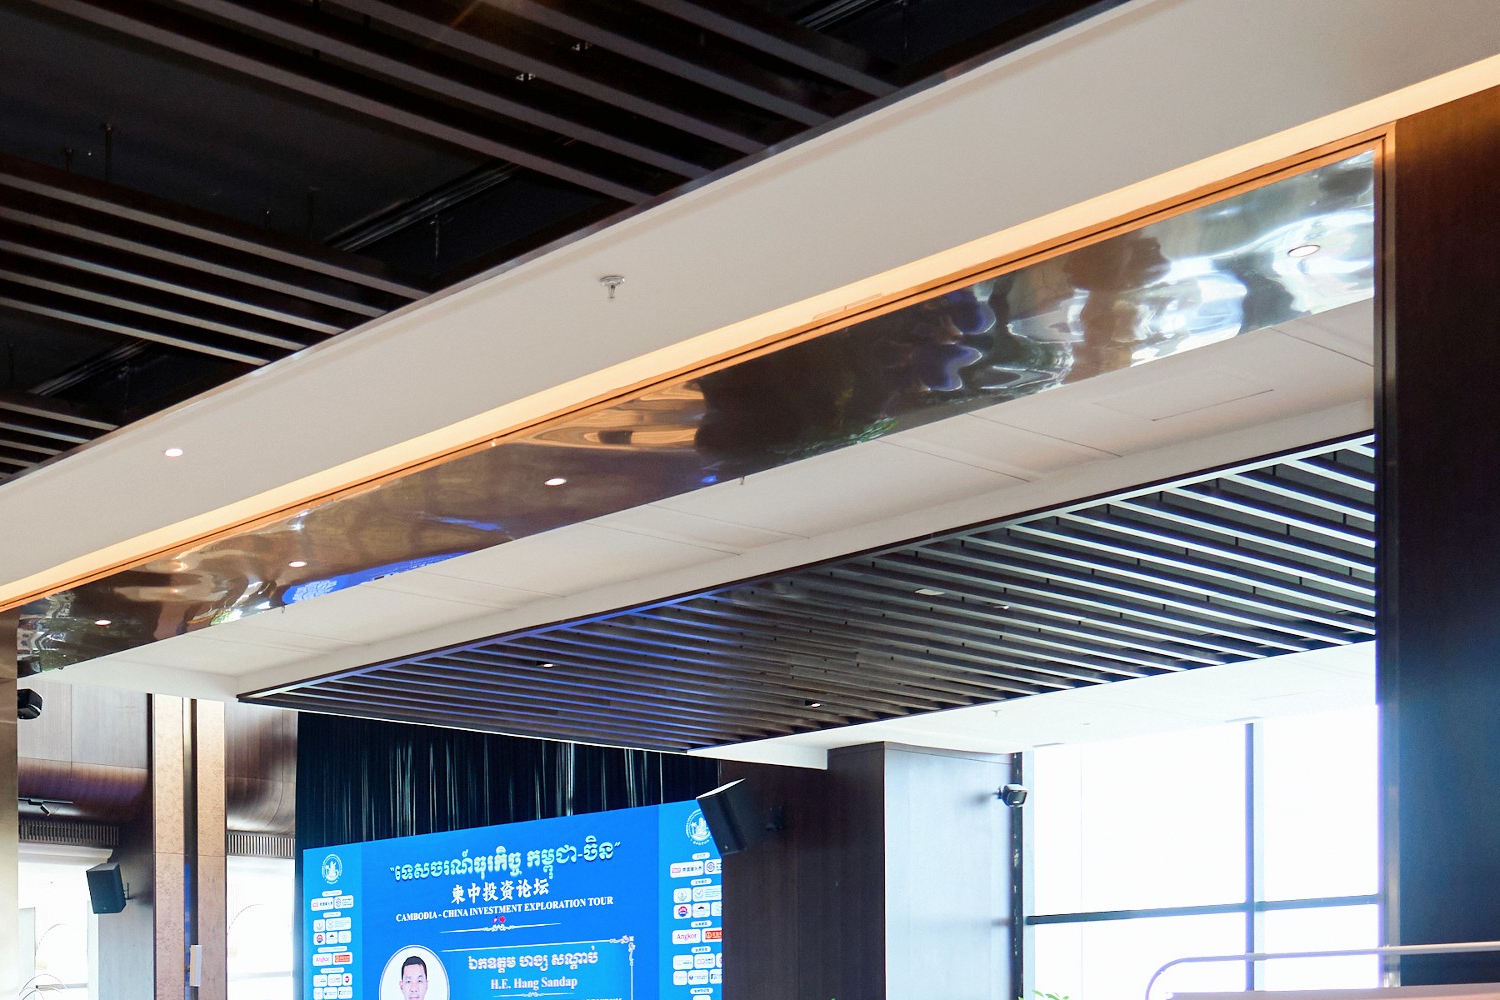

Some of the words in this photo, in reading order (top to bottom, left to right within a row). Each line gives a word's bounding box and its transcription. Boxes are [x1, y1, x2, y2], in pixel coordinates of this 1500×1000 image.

[451, 878, 549, 904] 柬中投资论坛
[396, 910, 438, 922] CAMBODIA
[443, 907, 468, 918] CHINA
[469, 904, 522, 917] INVESTMENT
[524, 899, 586, 912] EXPLORATION
[588, 896, 614, 906] TOUR
[490, 978, 511, 989] H.E.
[513, 977, 539, 990] Hang
[541, 976, 578, 990] Sandap
